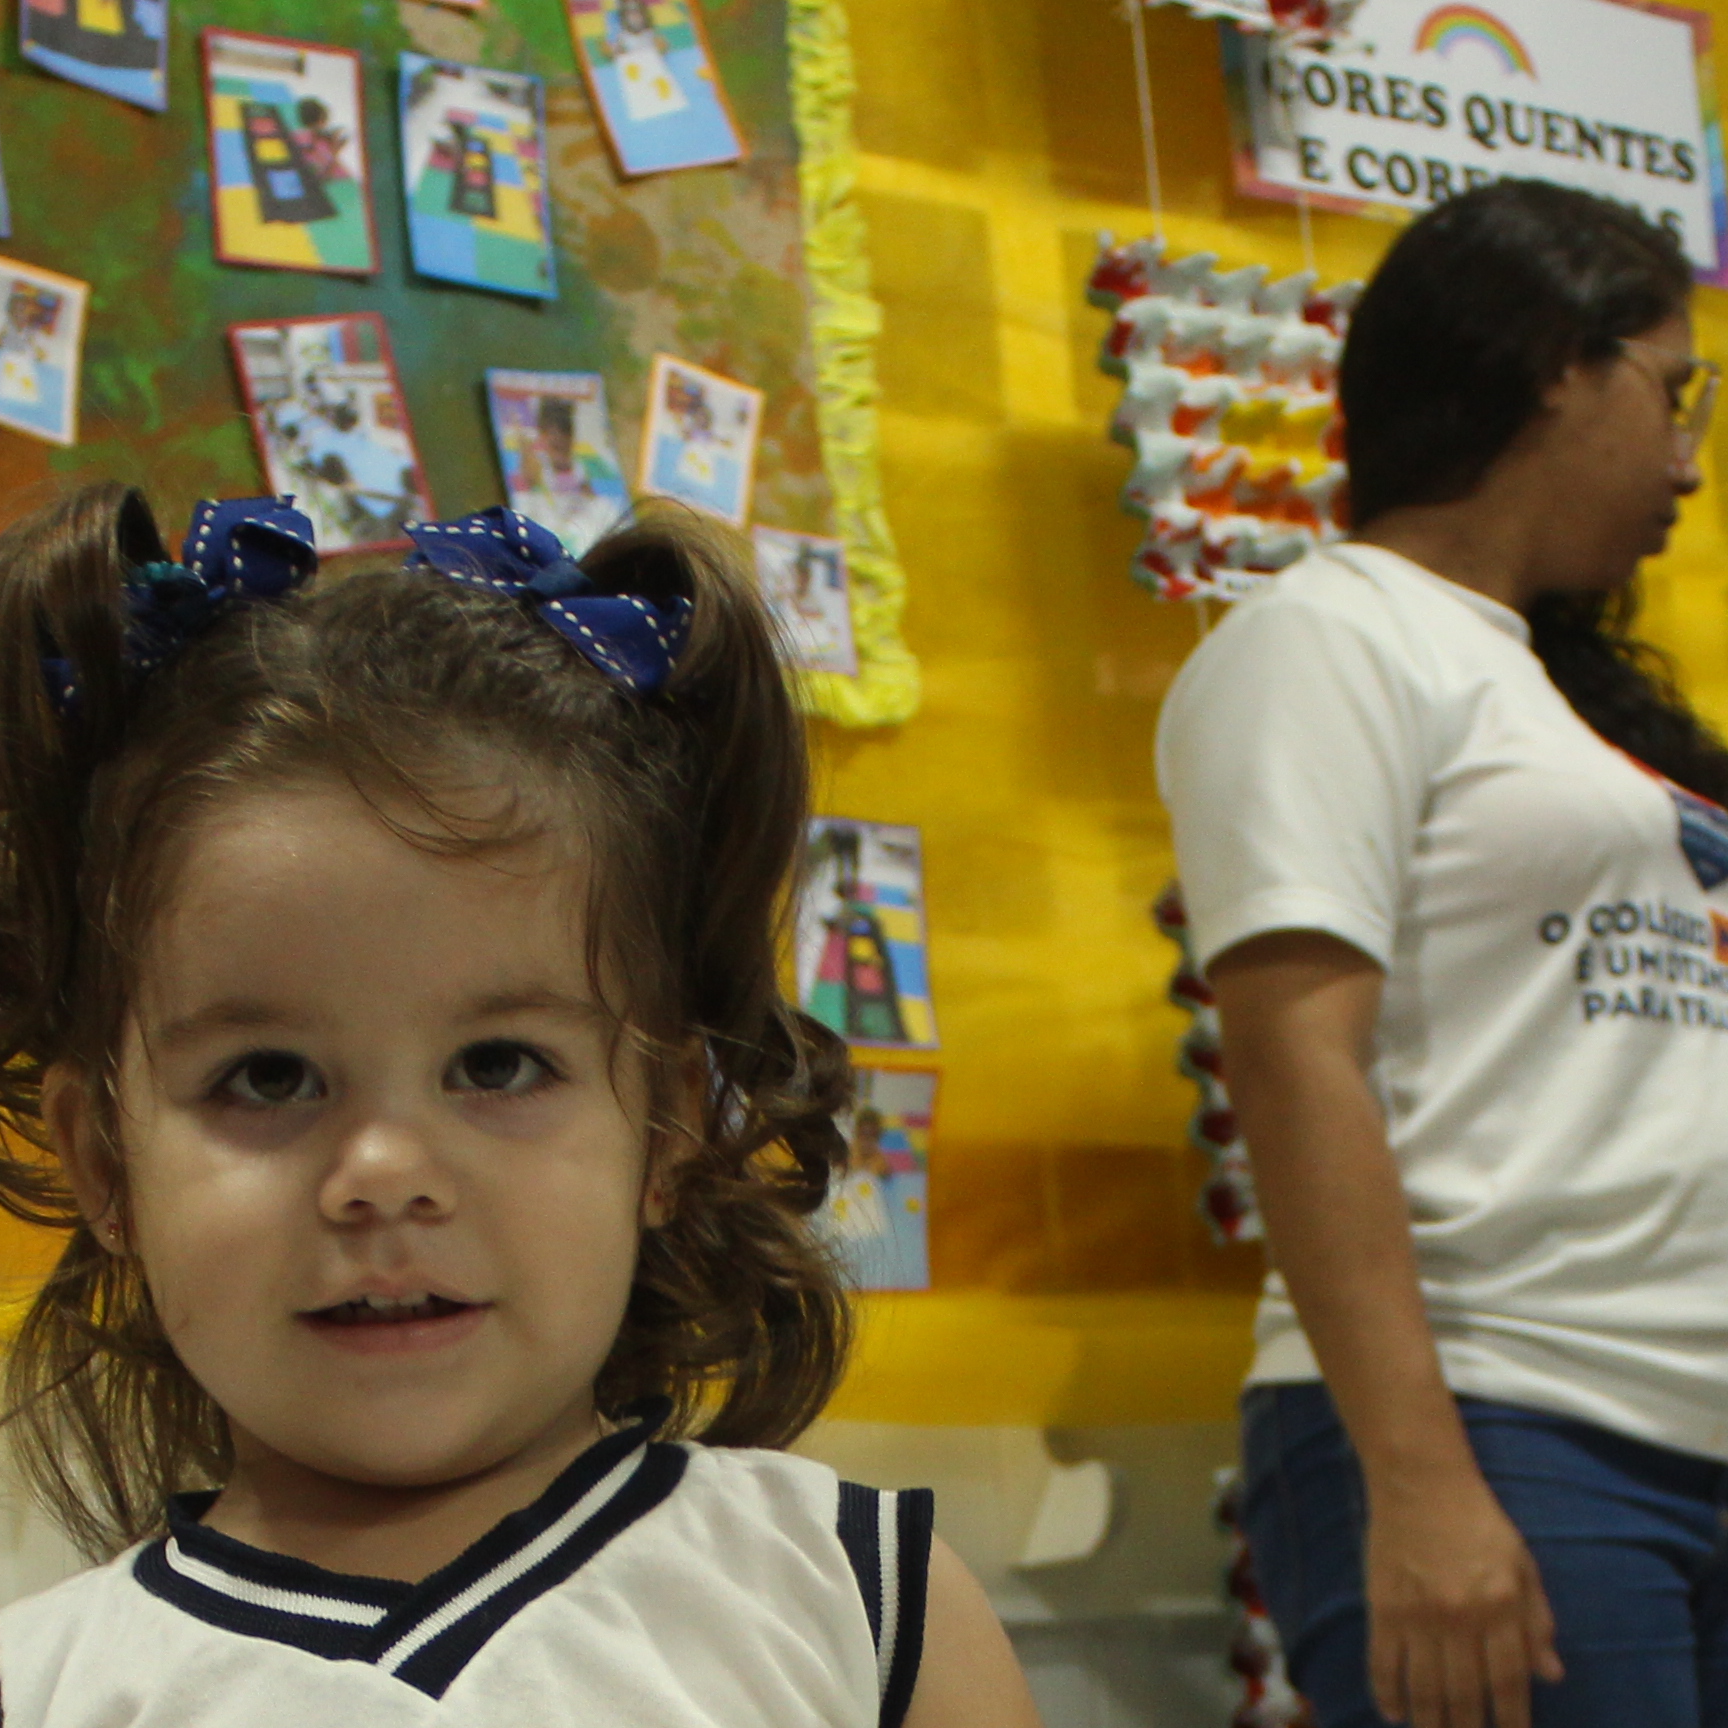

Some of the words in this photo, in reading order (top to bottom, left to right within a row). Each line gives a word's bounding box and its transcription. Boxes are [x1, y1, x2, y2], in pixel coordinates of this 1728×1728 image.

[1298, 134, 1330, 182] E
[1464, 93, 1696, 184] QUENTES
[1538, 911, 1571, 943] O
